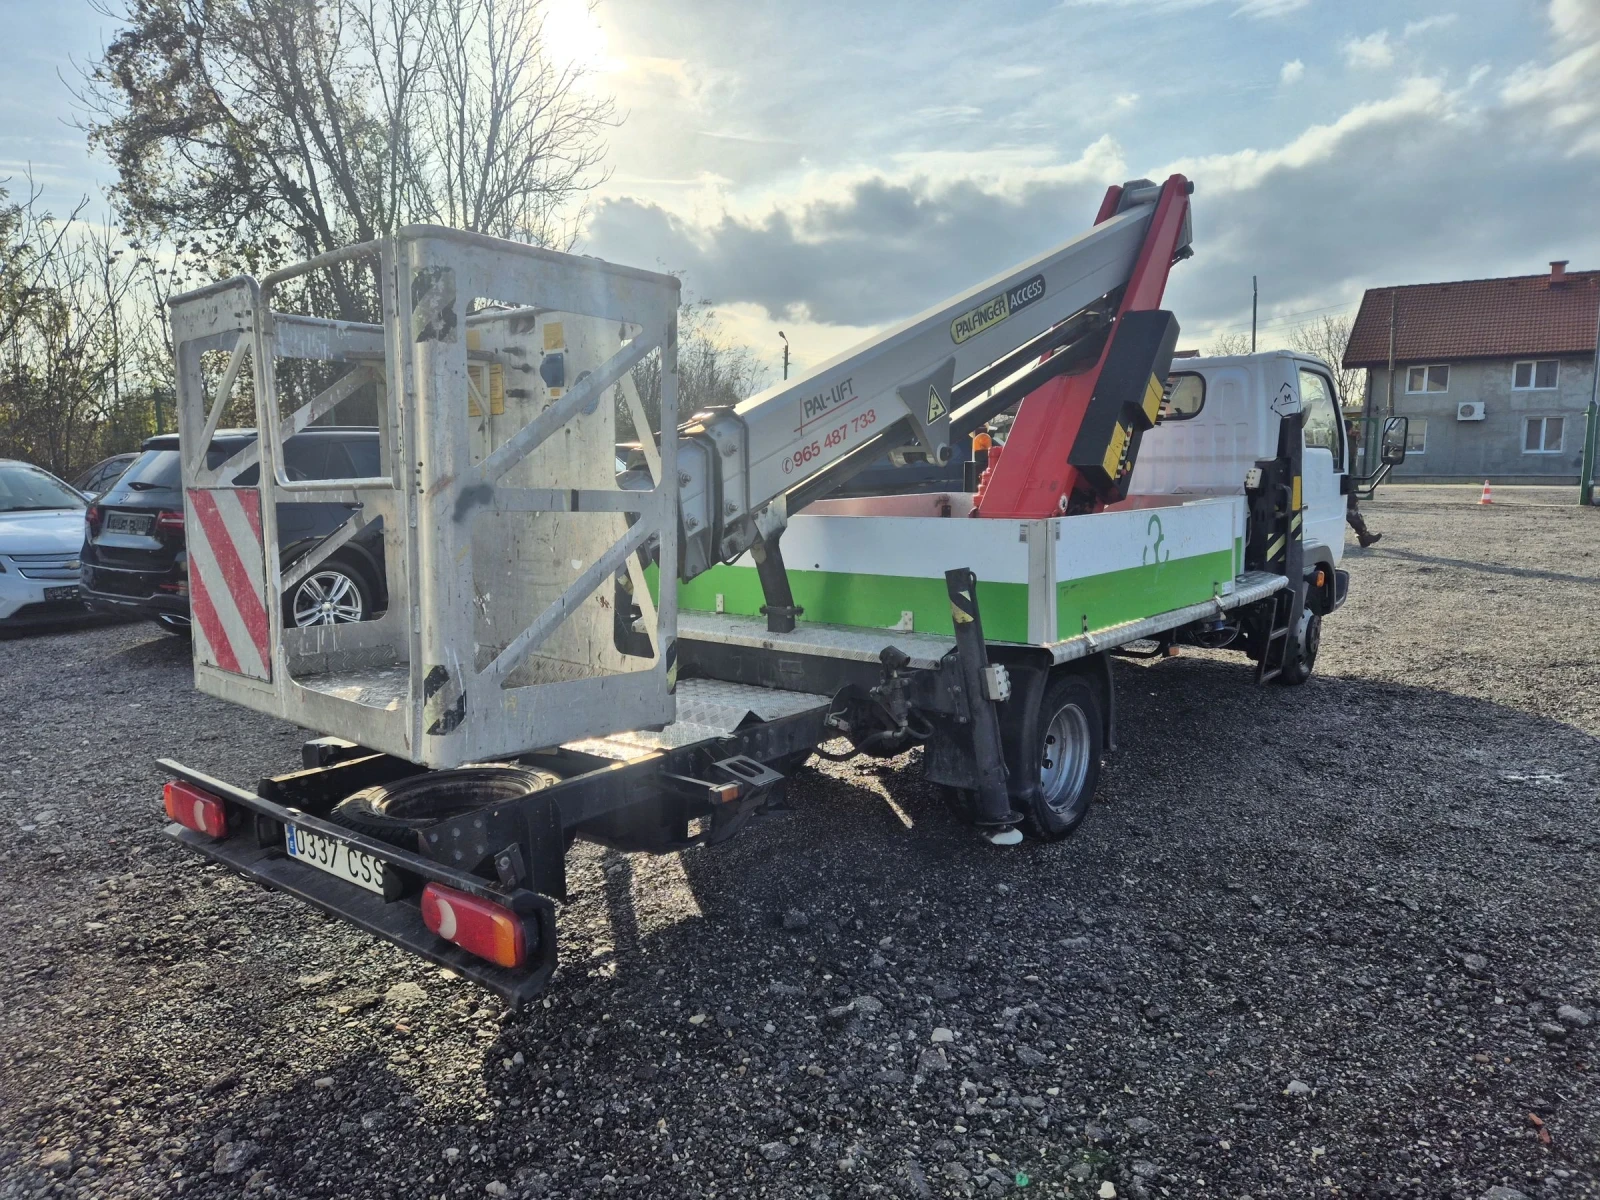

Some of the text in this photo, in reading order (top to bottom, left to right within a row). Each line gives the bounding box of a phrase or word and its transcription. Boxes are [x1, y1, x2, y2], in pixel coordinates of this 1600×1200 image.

[955, 279, 1042, 338] PALFINGER ACCESS
[803, 377, 853, 419] PAL-LIFT
[793, 409, 876, 467] 965 487 733
[296, 829, 384, 889] 0337 CSS
